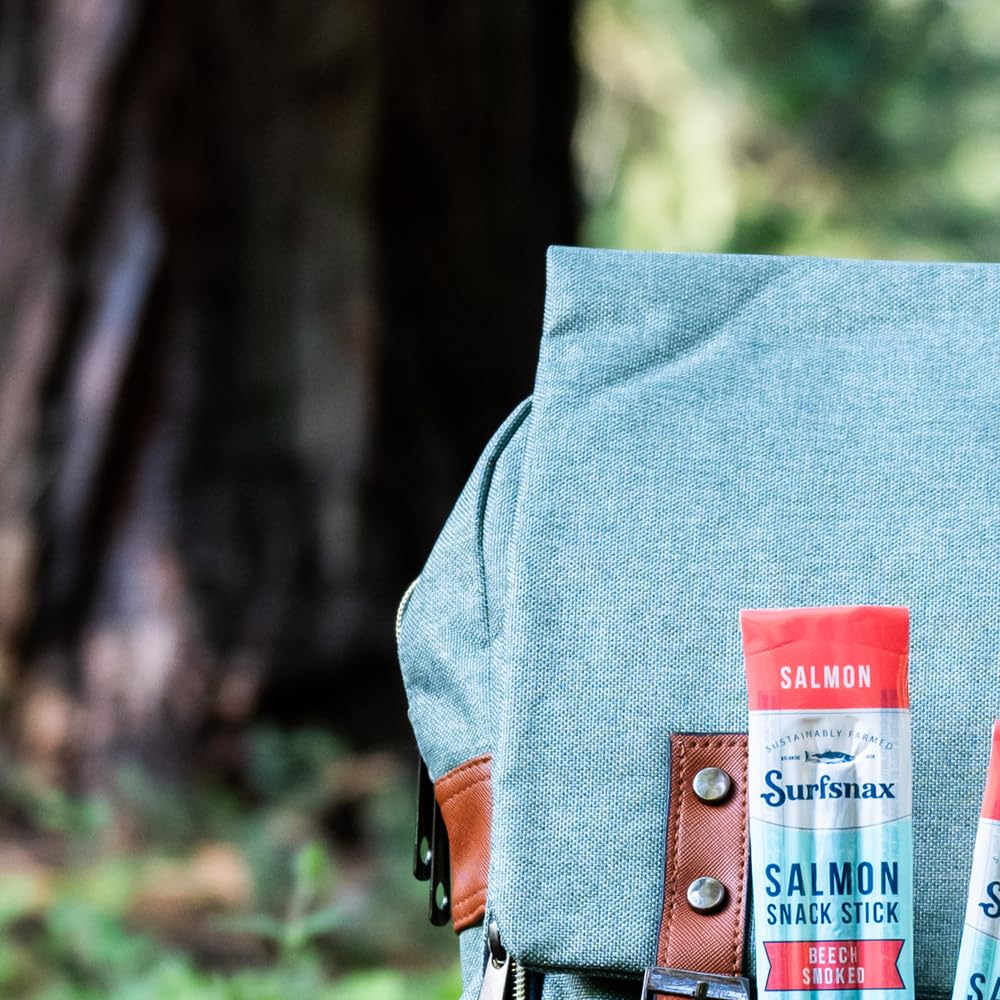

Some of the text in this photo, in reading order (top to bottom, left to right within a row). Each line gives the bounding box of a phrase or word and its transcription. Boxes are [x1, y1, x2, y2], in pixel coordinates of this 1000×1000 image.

[780, 665, 871, 689] SALMON
[765, 729, 894, 753] SUSTAINABLY FARMED
[760, 769, 896, 808] Surfsnax
[765, 861, 899, 898] SALMON
[767, 901, 900, 926] SNACK STICK
[808, 946, 858, 965] BEECH
[802, 967, 865, 985] SMOKED
